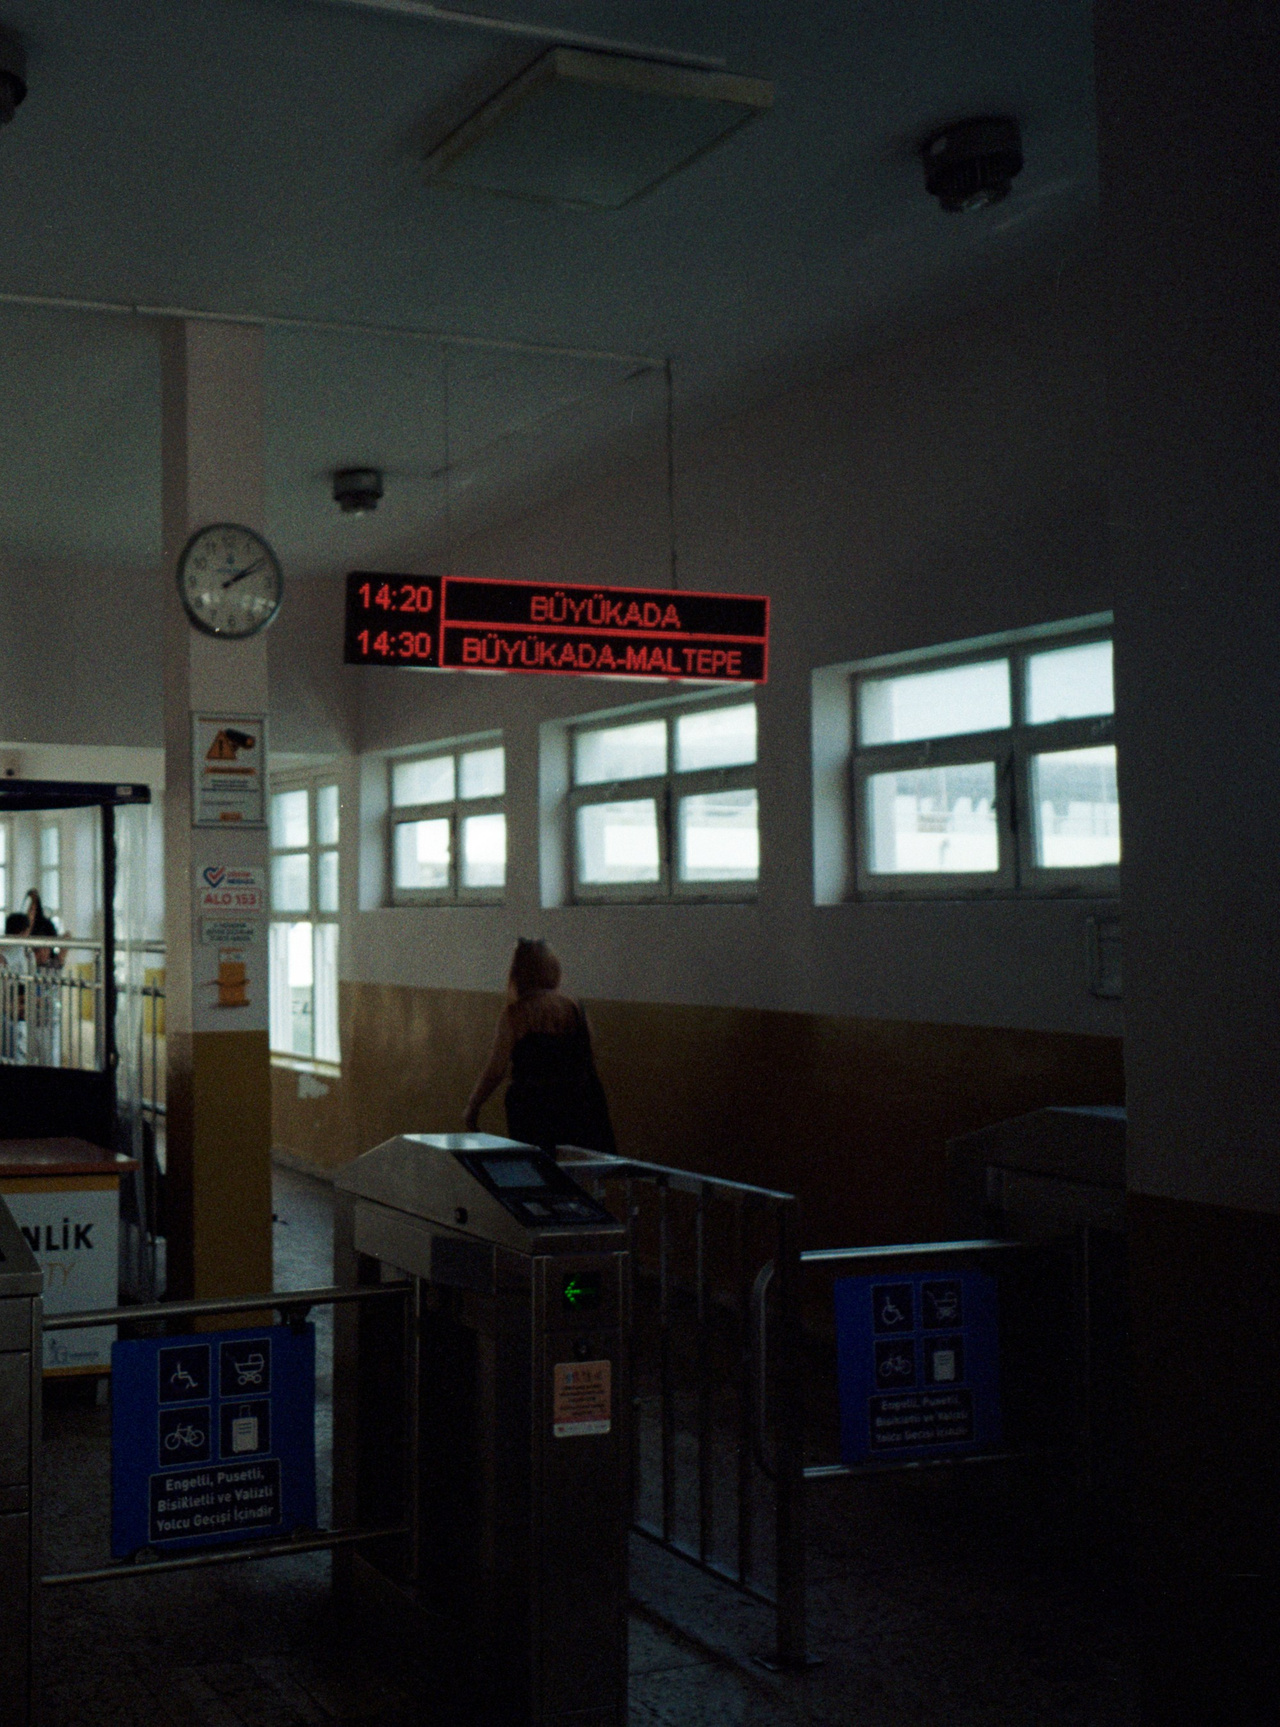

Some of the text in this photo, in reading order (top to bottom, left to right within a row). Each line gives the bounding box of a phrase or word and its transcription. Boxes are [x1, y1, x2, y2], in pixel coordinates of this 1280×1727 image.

[359, 583, 433, 613] 14:20
[530, 592, 681, 629] BÜYÜKADA
[357, 630, 431, 658] 14:30
[462, 634, 742, 675] BÜYÜKADA-MALTEPE
[204, 893, 257, 905] ALO 153
[165, 1467, 265, 1492] Engelli, Pusetli,
[157, 1484, 274, 1513] Bisikletli ve Valizli
[156, 1505, 275, 1532] Yolcu Geçişi İçindir
